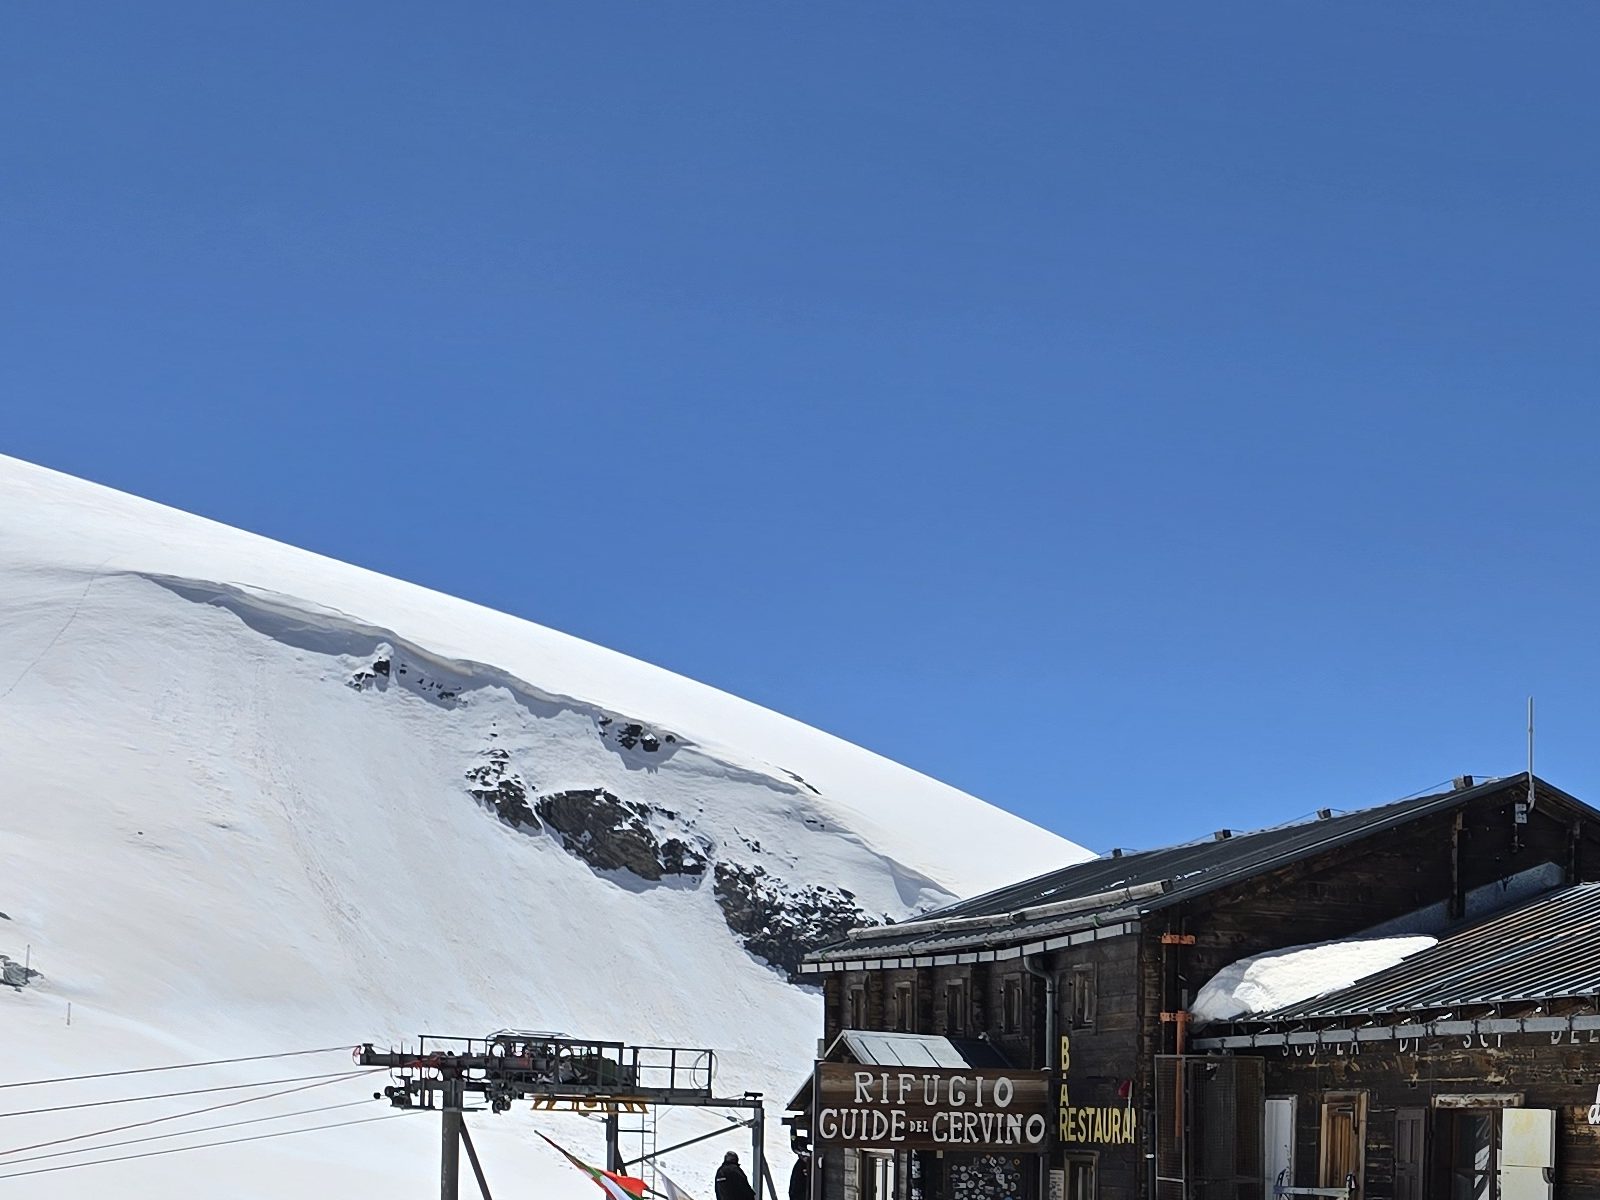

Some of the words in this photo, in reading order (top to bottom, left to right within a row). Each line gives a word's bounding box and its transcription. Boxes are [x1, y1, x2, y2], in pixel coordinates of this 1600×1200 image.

[854, 1072, 1015, 1109] RIFUGIO
[819, 1108, 907, 1142] GUIDE
[909, 1120, 929, 1133] DEL
[932, 1111, 1046, 1145] CERVINO
